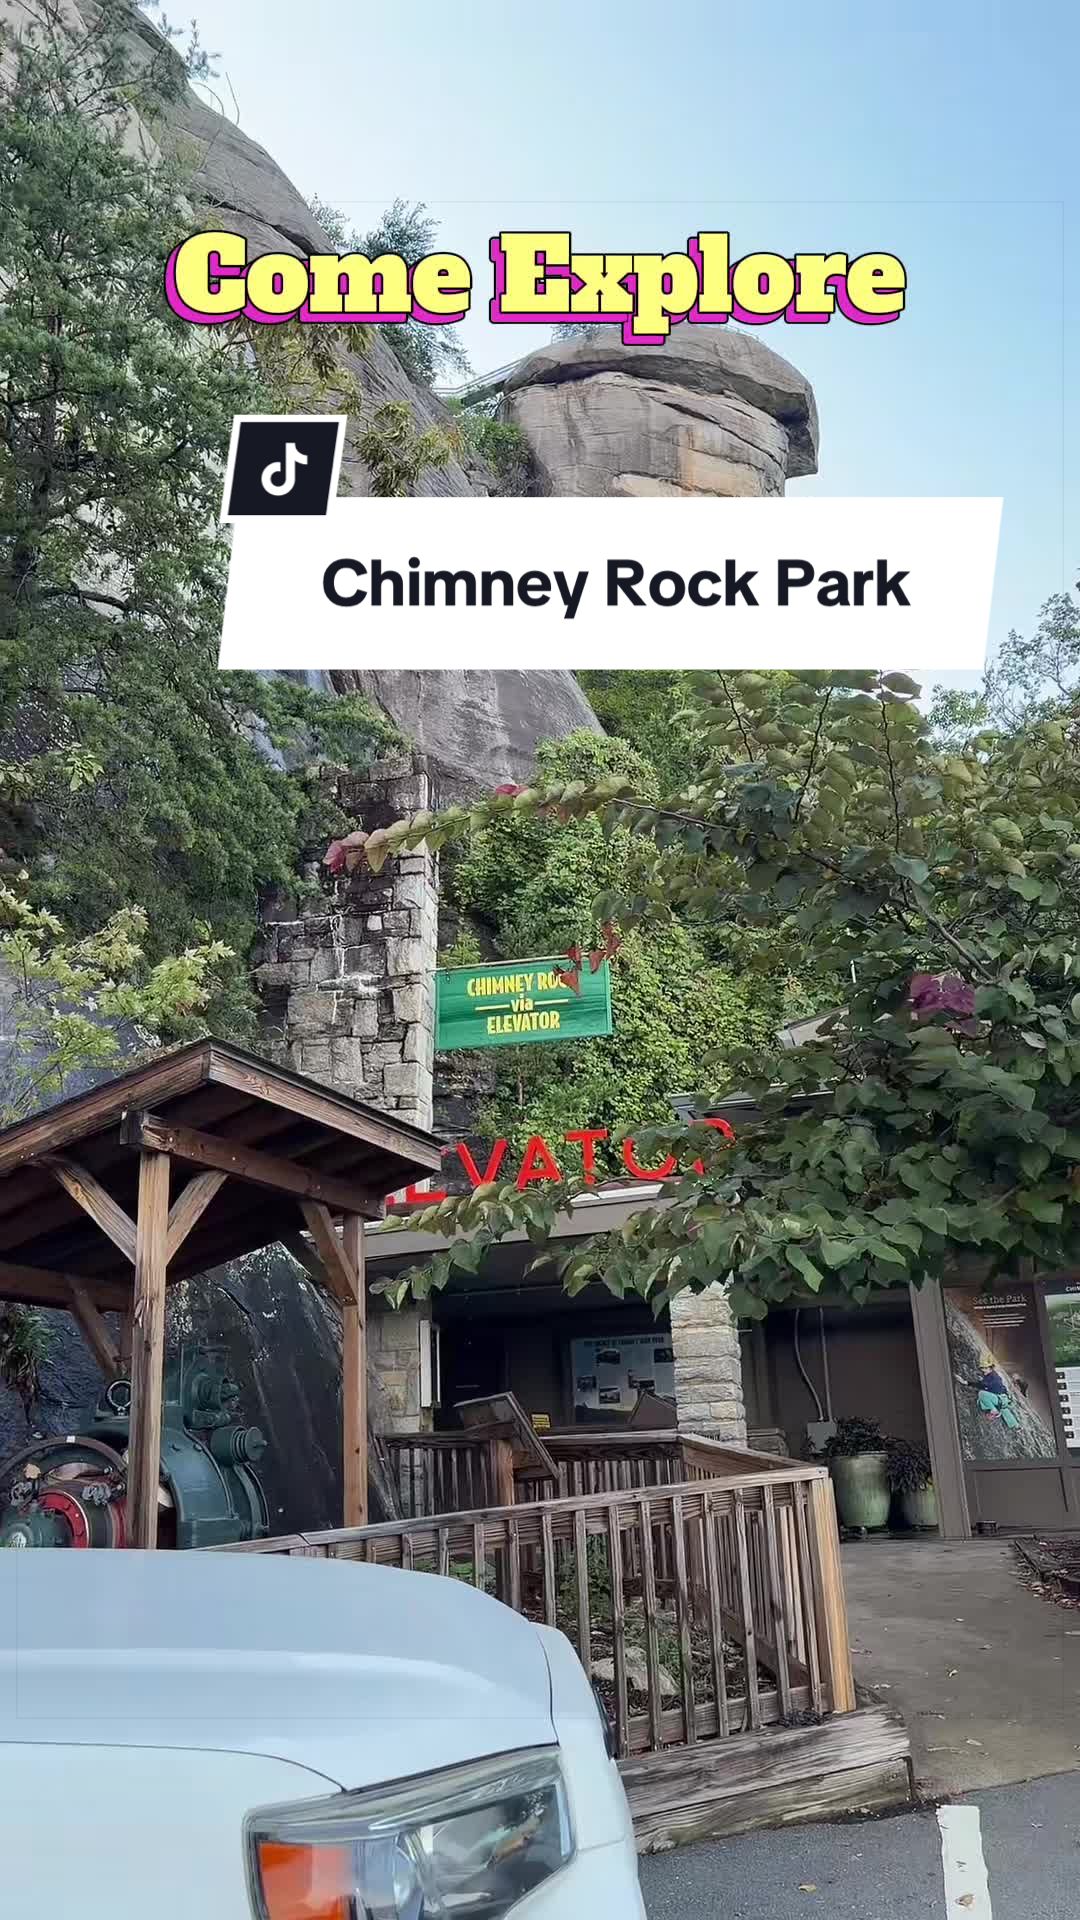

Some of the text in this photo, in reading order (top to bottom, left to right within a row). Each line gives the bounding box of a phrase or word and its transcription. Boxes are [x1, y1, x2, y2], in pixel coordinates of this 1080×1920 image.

[467, 971, 569, 997] CHIMNEY ROC
[510, 993, 534, 1013] via
[487, 1011, 561, 1035] ELEVATOR
[1006, 1293, 1028, 1303] Park
